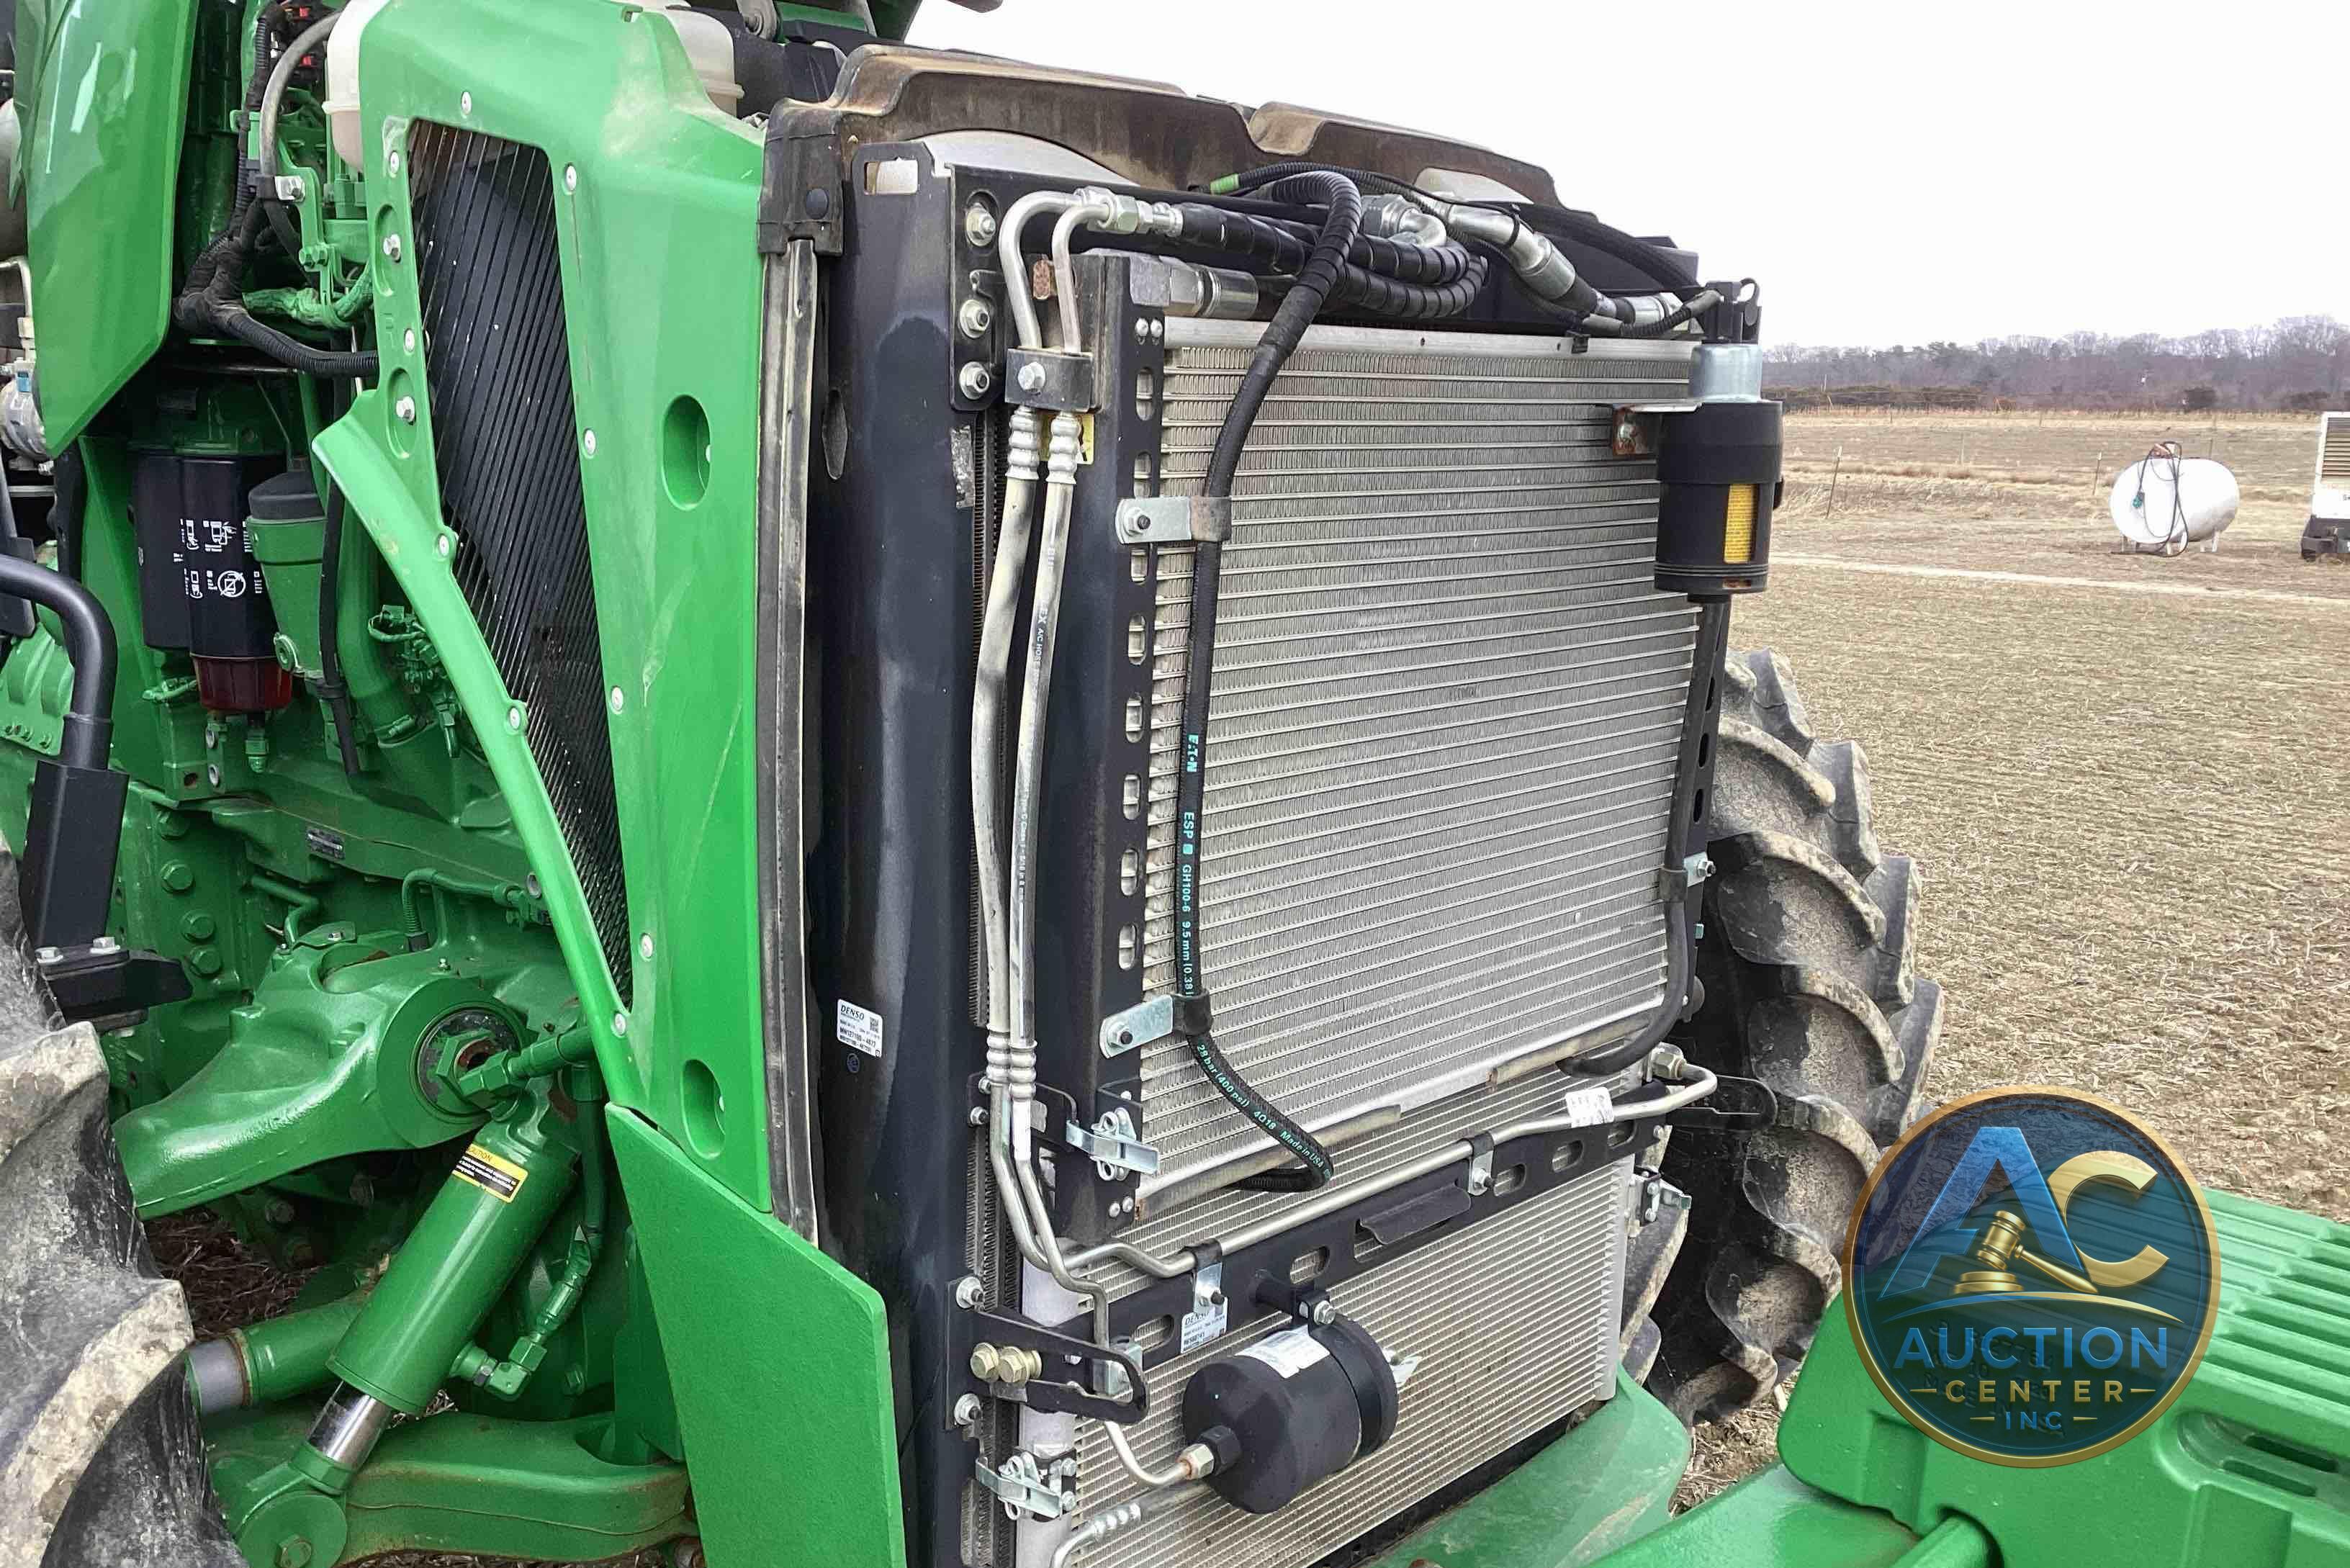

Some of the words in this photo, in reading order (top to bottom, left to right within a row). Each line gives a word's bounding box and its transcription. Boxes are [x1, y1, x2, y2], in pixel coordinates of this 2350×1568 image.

[1183, 812, 1194, 839] ESP
[1181, 864, 1192, 913] GH100-6
[1182, 940, 1190, 961] mm
[841, 1005, 865, 1020] DENSO
[1197, 1044, 1208, 1057] 28
[1204, 1057, 1217, 1073] bar
[1215, 1073, 1234, 1092] (400
[1280, 1131, 1302, 1150] Made
[1309, 1153, 1324, 1167] USA
